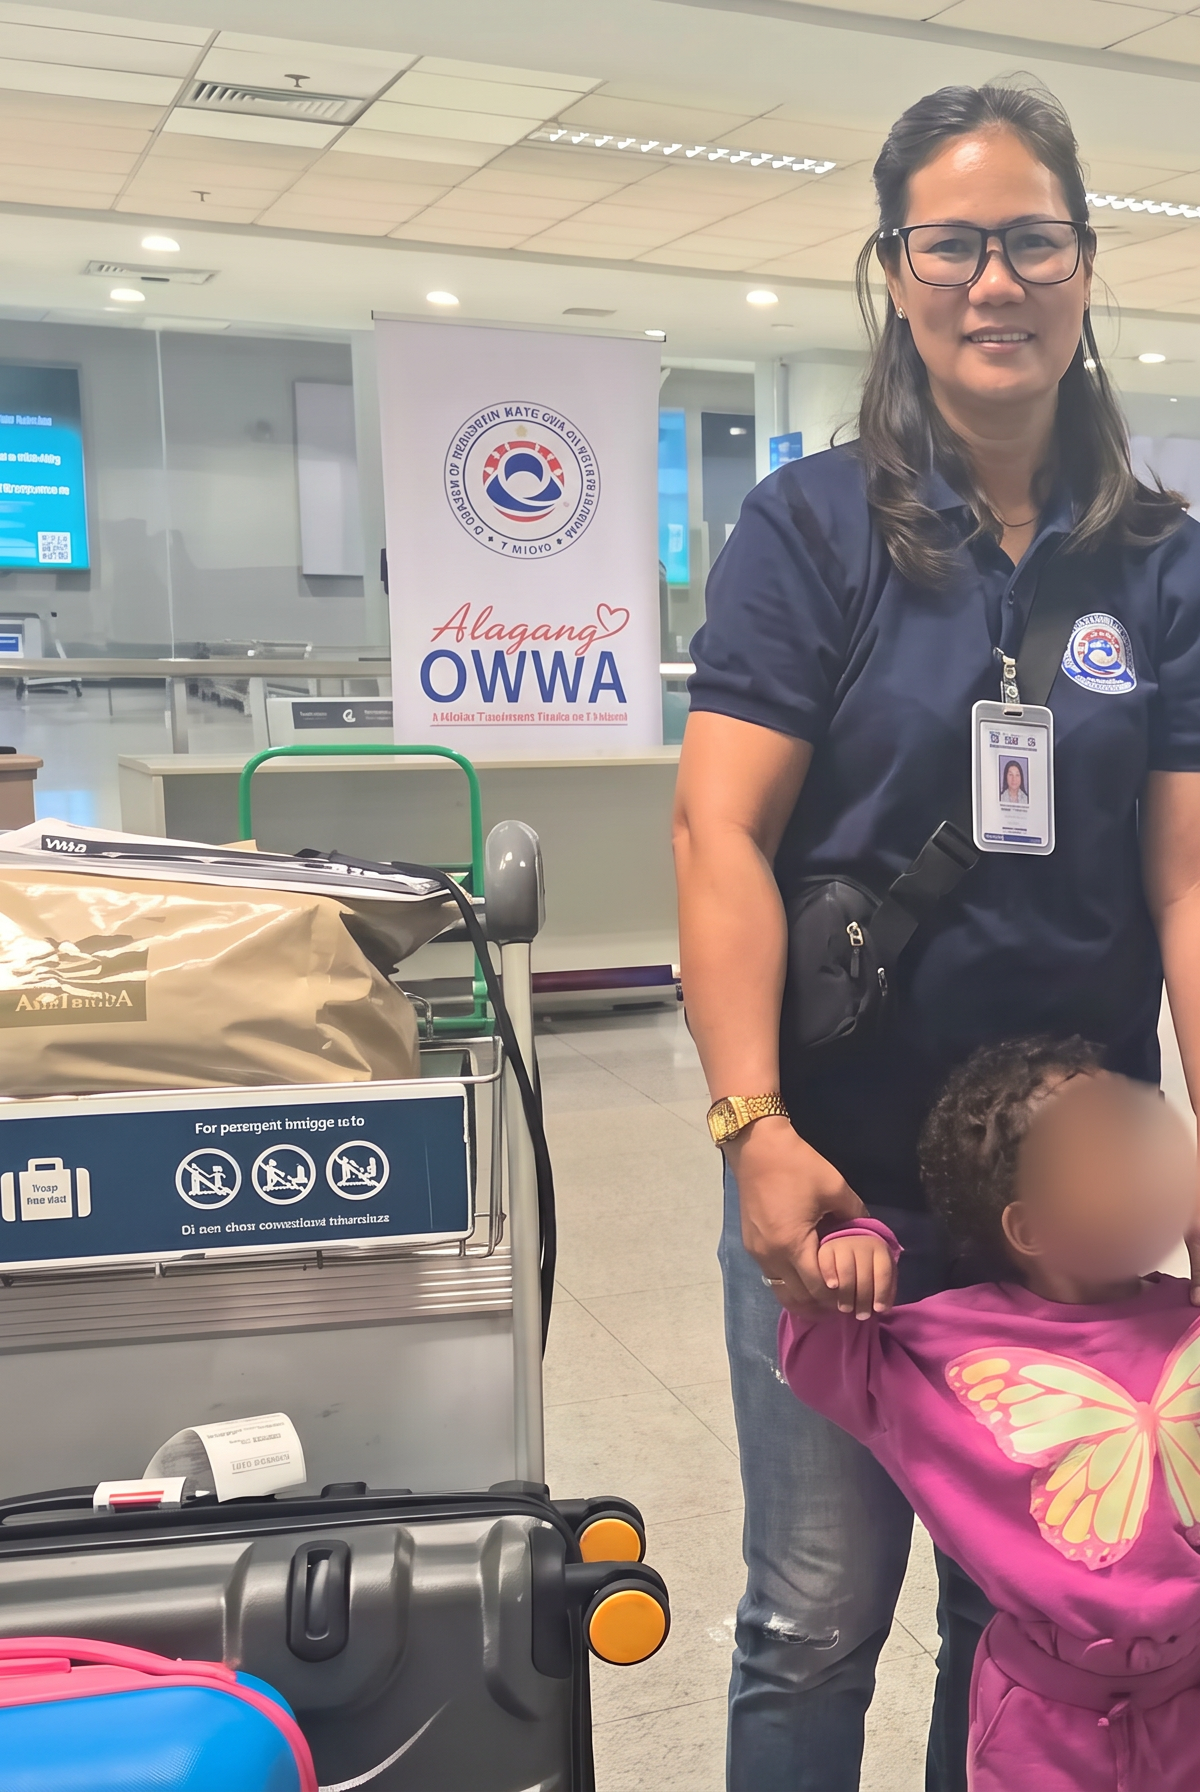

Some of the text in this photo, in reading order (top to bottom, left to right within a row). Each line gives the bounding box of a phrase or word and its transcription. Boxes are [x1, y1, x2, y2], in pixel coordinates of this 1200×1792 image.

[430, 602, 600, 657] Alagang
[420, 649, 628, 704] OWWA
[195, 1122, 217, 1134] For
